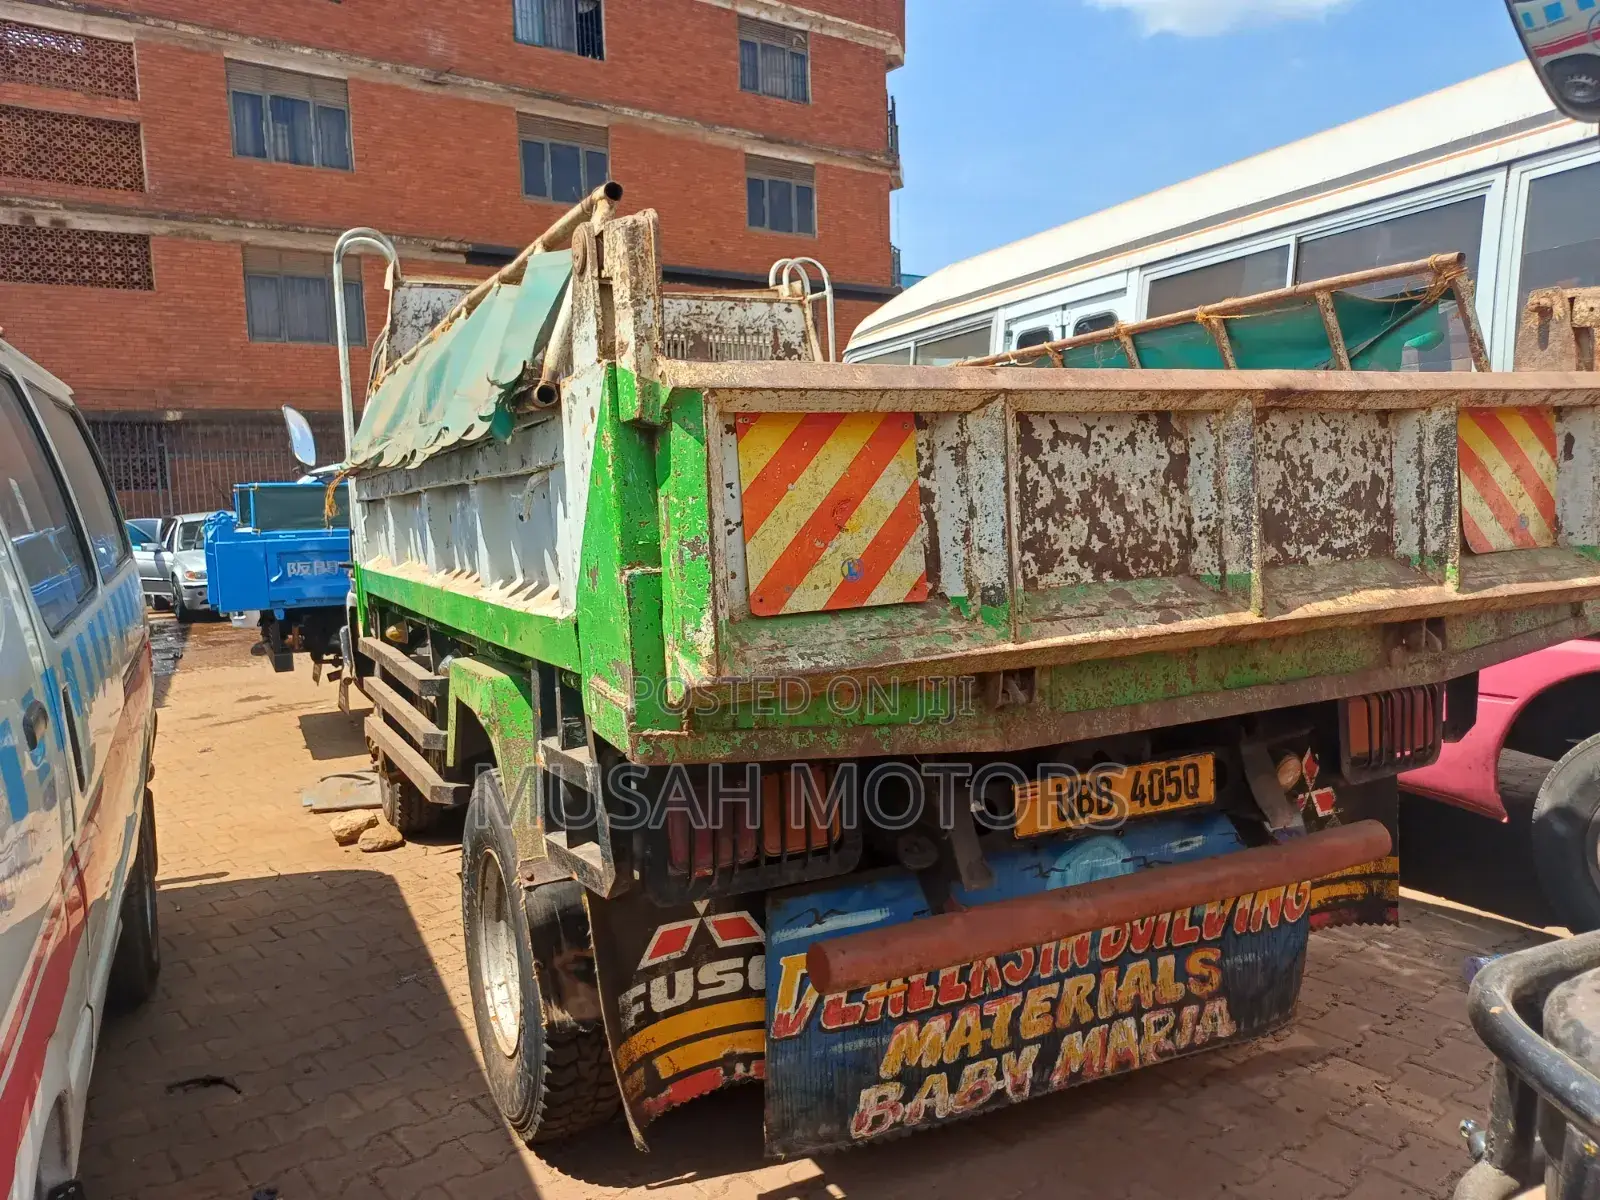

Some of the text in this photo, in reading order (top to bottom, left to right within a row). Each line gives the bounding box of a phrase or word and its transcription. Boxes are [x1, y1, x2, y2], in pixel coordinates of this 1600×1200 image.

[1130, 762, 1201, 808] 405Q
[850, 996, 1237, 1139] BABY MARIA
[879, 947, 1222, 1079] MATERIALS
